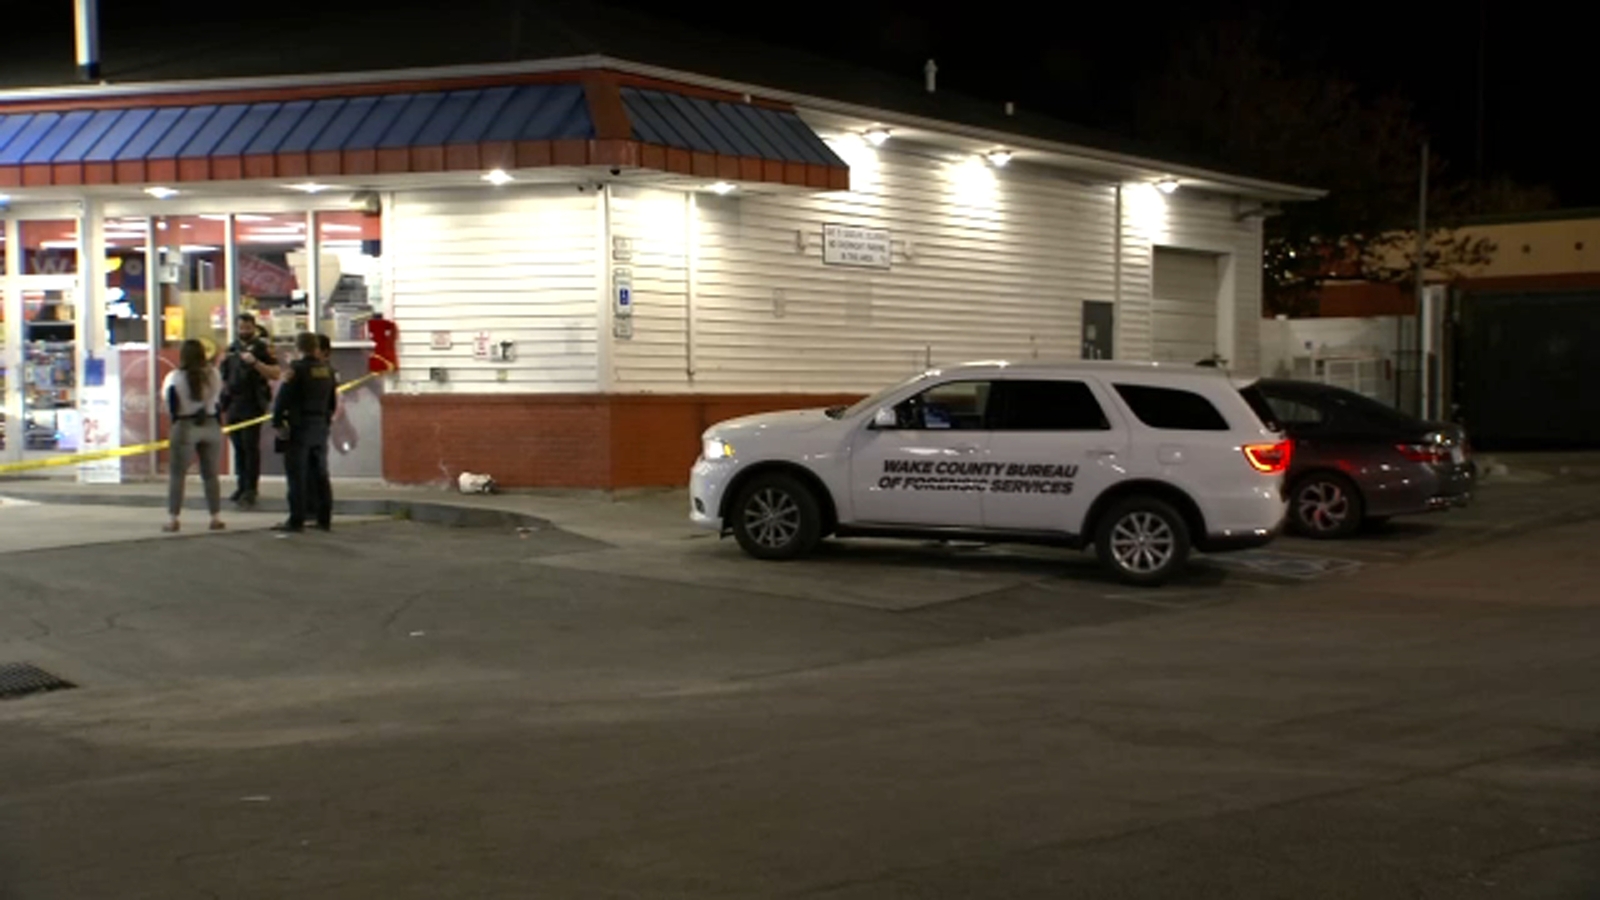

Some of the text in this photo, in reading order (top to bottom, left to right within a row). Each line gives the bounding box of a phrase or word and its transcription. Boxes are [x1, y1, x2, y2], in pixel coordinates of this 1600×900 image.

[883, 460, 1078, 478] WAKE COUNTY BUREAU
[878, 476, 1075, 495] OF FORENSIC SERVICES
